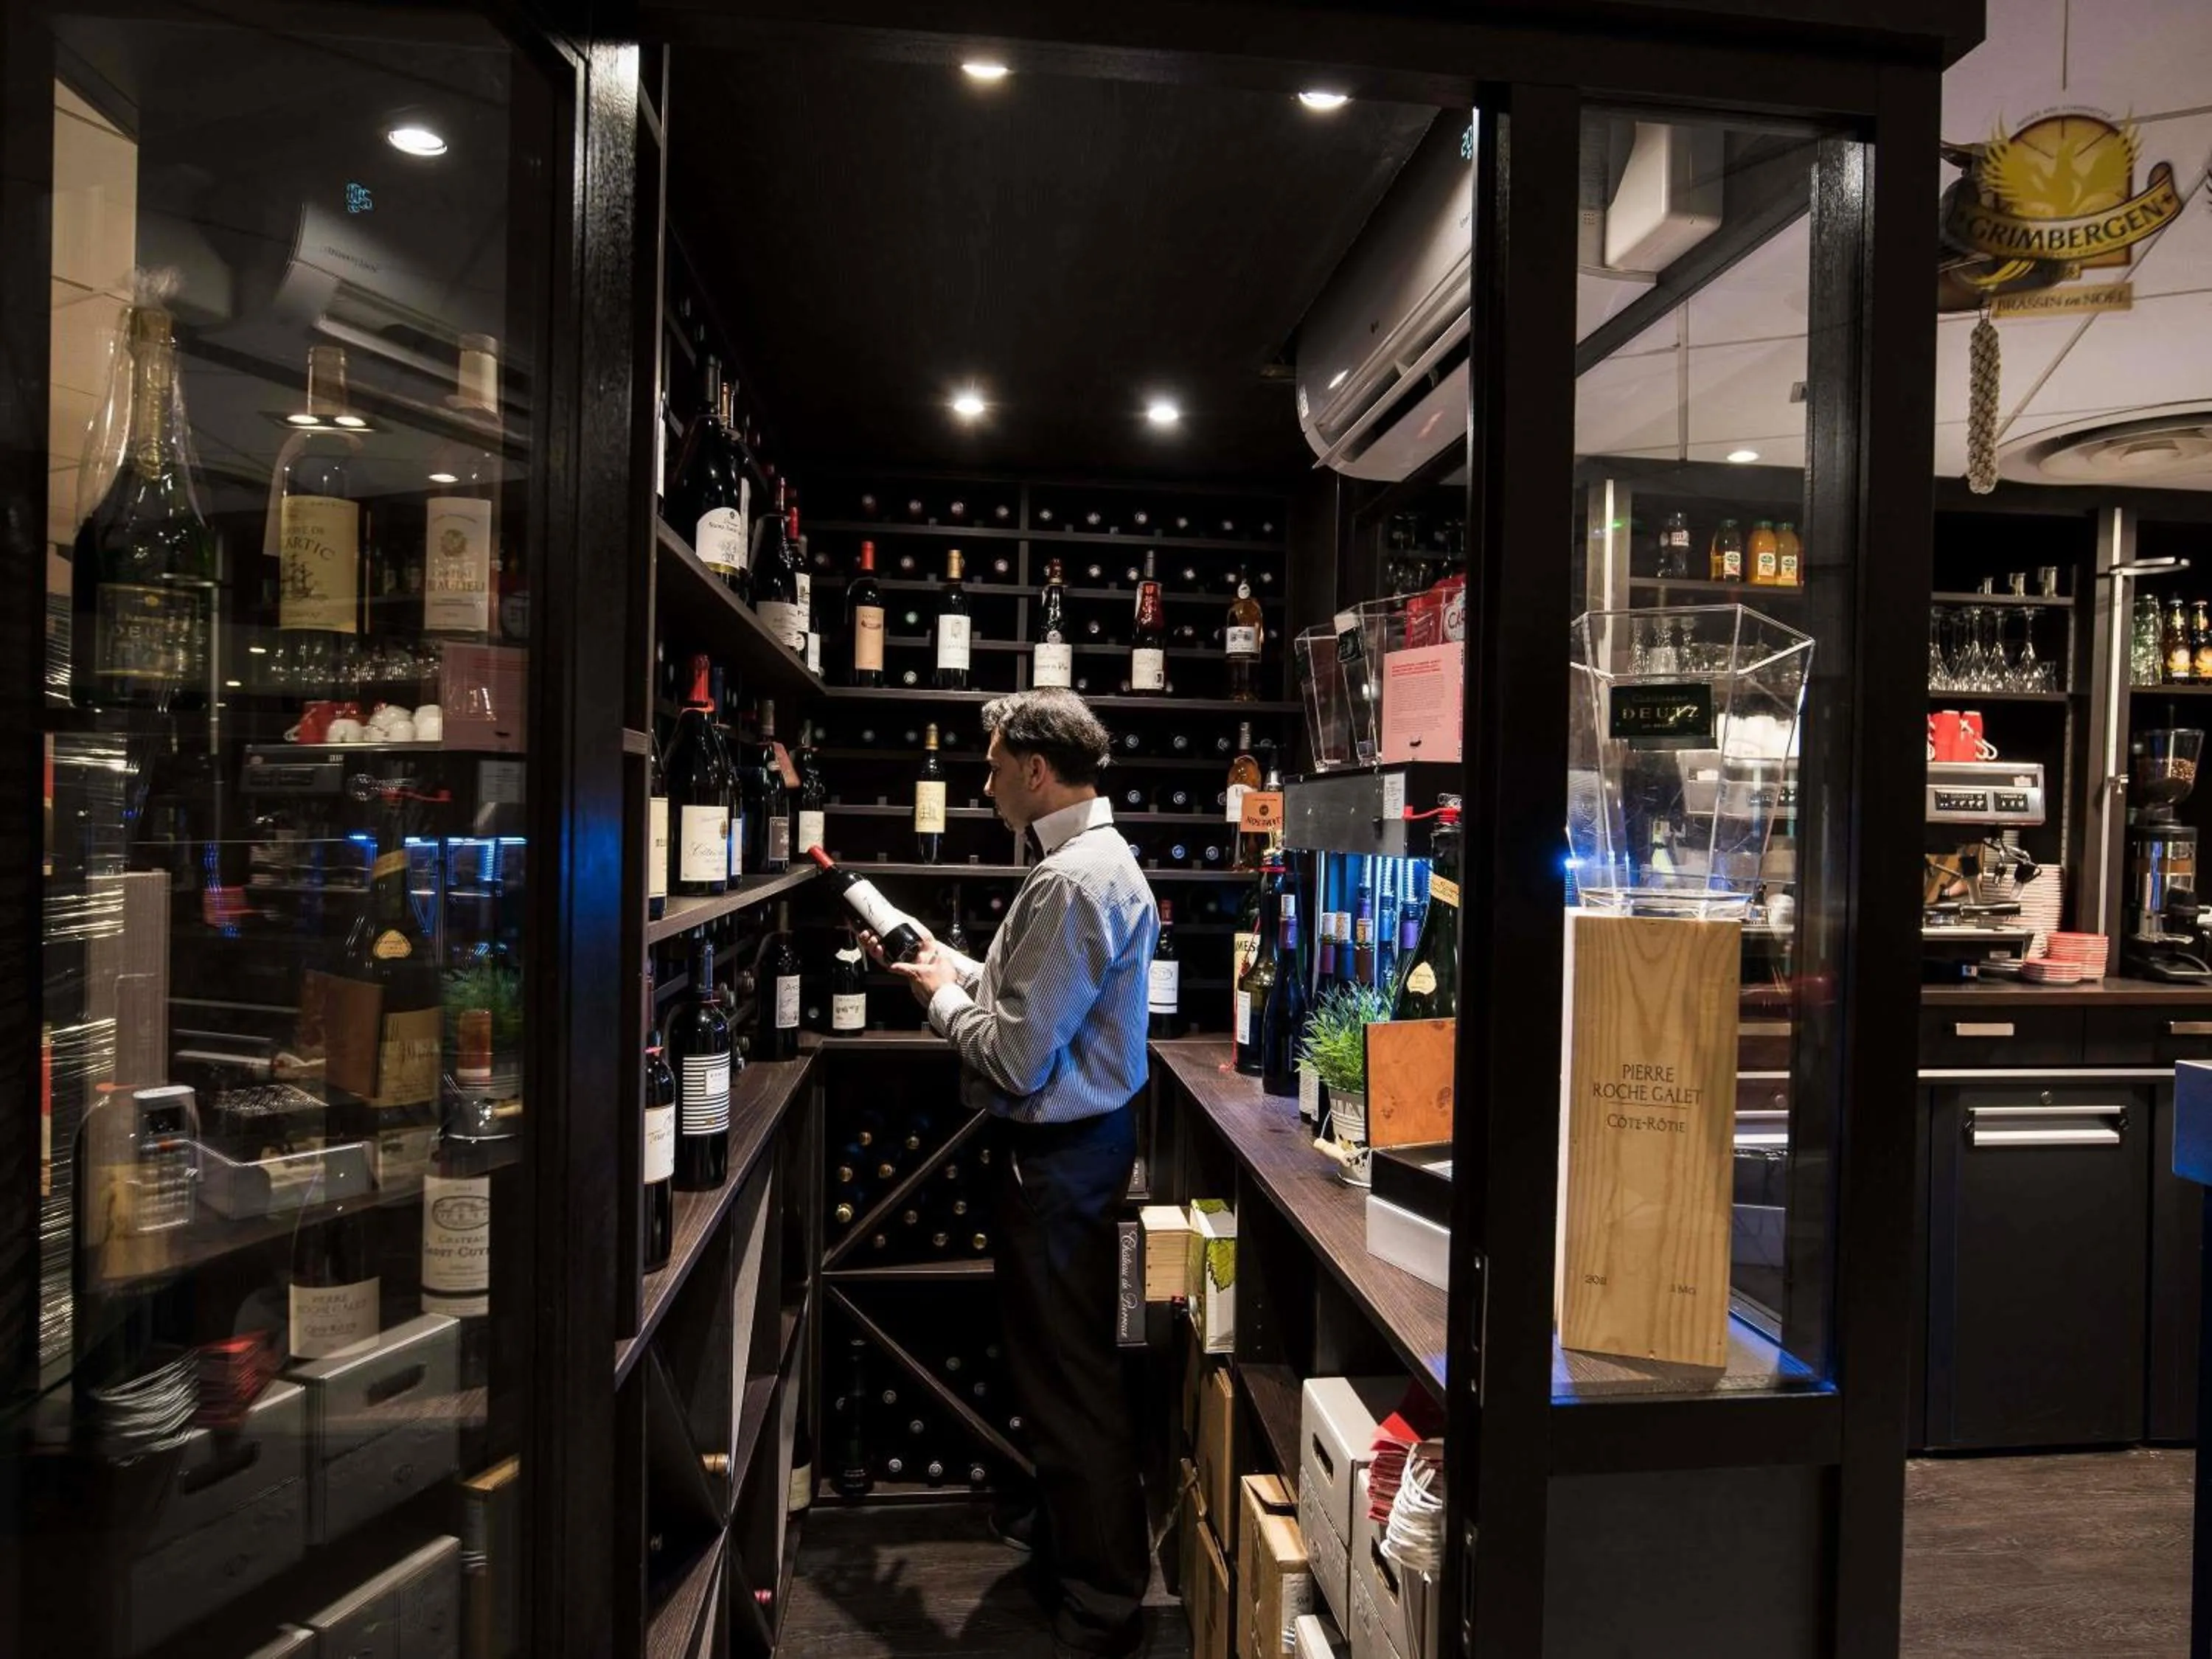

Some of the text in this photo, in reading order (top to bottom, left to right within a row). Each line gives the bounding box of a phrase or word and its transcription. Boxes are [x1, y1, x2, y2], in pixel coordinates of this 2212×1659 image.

[1969, 198, 2161, 251] GRIMBERGEN
[1621, 706, 1699, 720] DEUTZ
[1623, 1064, 1674, 1083] PIERRE
[1593, 1082, 1704, 1105] ROCHE GALET
